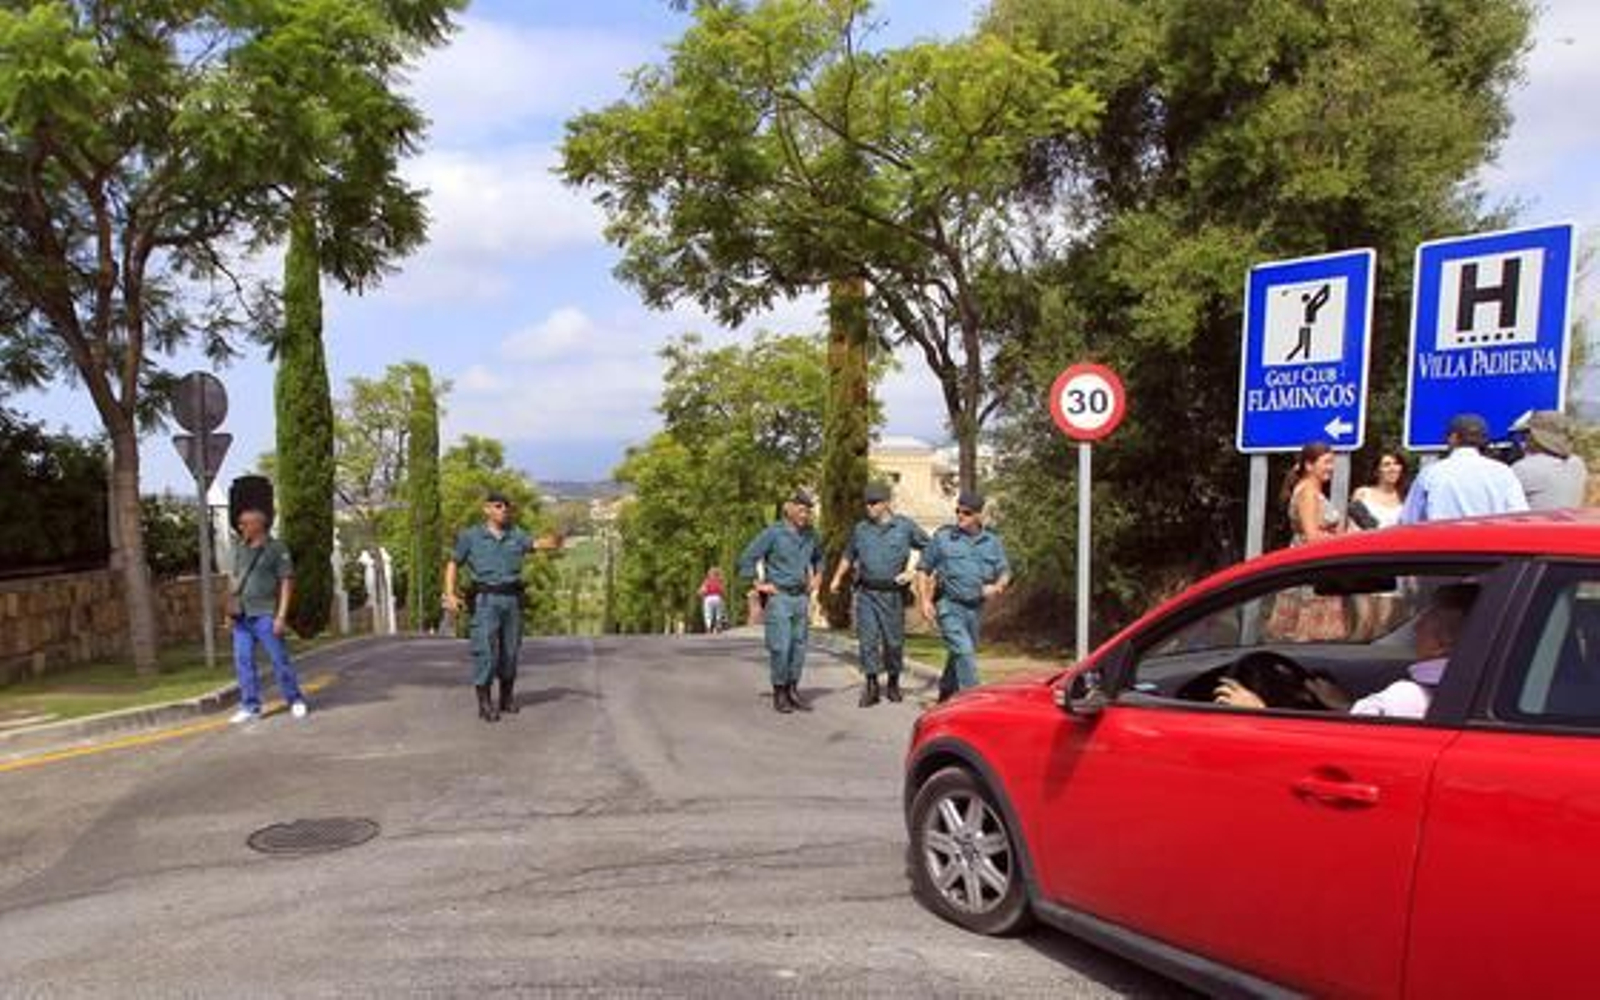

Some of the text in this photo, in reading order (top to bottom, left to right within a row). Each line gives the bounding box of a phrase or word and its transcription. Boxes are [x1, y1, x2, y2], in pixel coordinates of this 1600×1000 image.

[1456, 257, 1521, 332] H
[1418, 347, 1557, 378] VILLA PADIERNA
[1067, 389, 1108, 414] 30
[1247, 383, 1356, 411] FLAMINGOS
